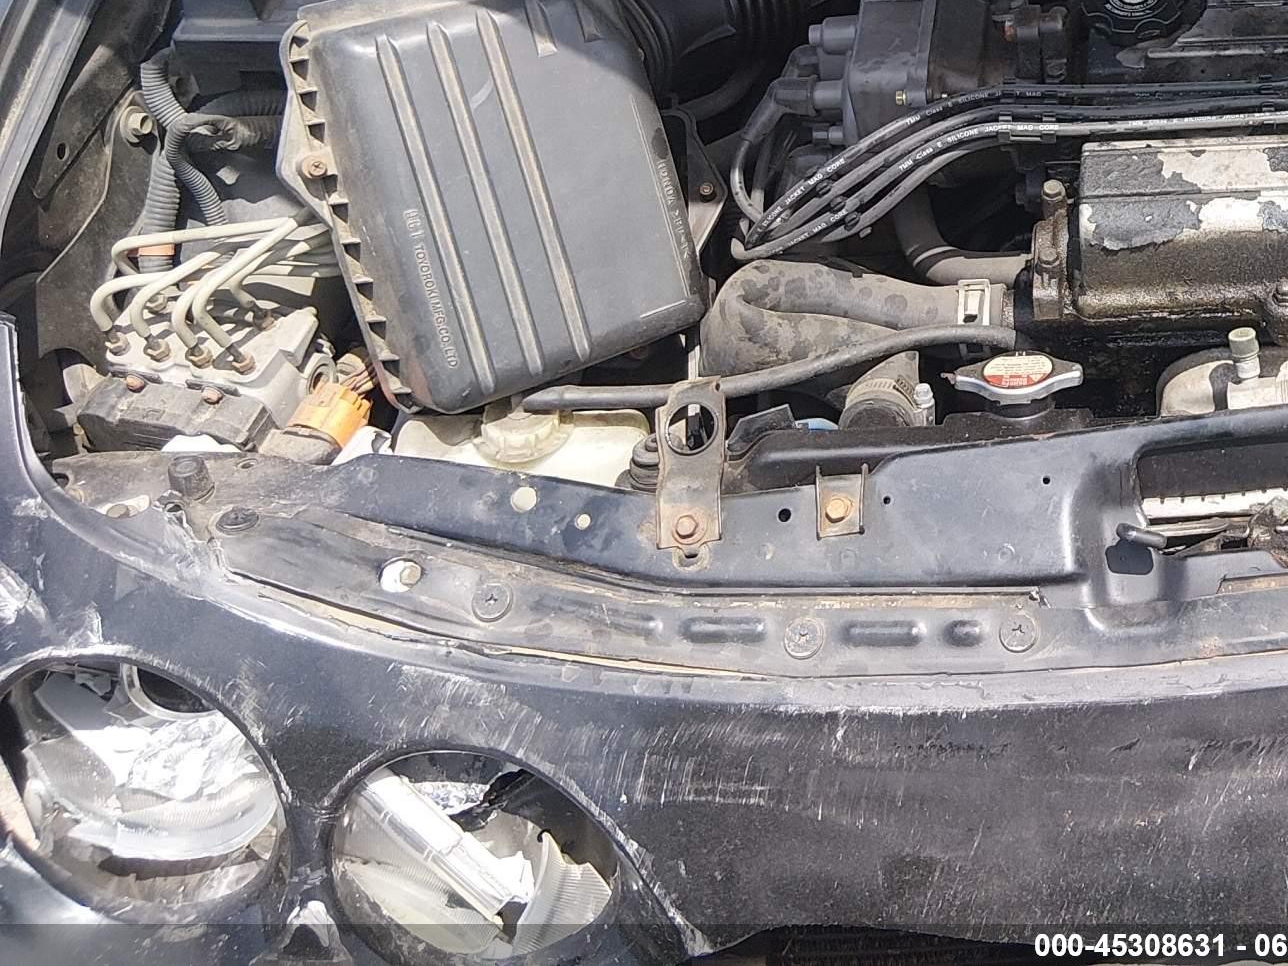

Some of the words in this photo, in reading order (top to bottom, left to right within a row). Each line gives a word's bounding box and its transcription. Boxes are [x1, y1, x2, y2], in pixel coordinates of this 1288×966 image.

[946, 123, 979, 147] SILICONE
[1016, 123, 1033, 131] MAG
[655, 158, 679, 205] HONDA
[760, 205, 784, 227] SILICONE
[783, 185, 806, 205] JACKET
[807, 171, 823, 186] MAG
[825, 155, 846, 174] CORE
[829, 208, 848, 222] CORE
[414, 243, 437, 299] TOYOROKI
